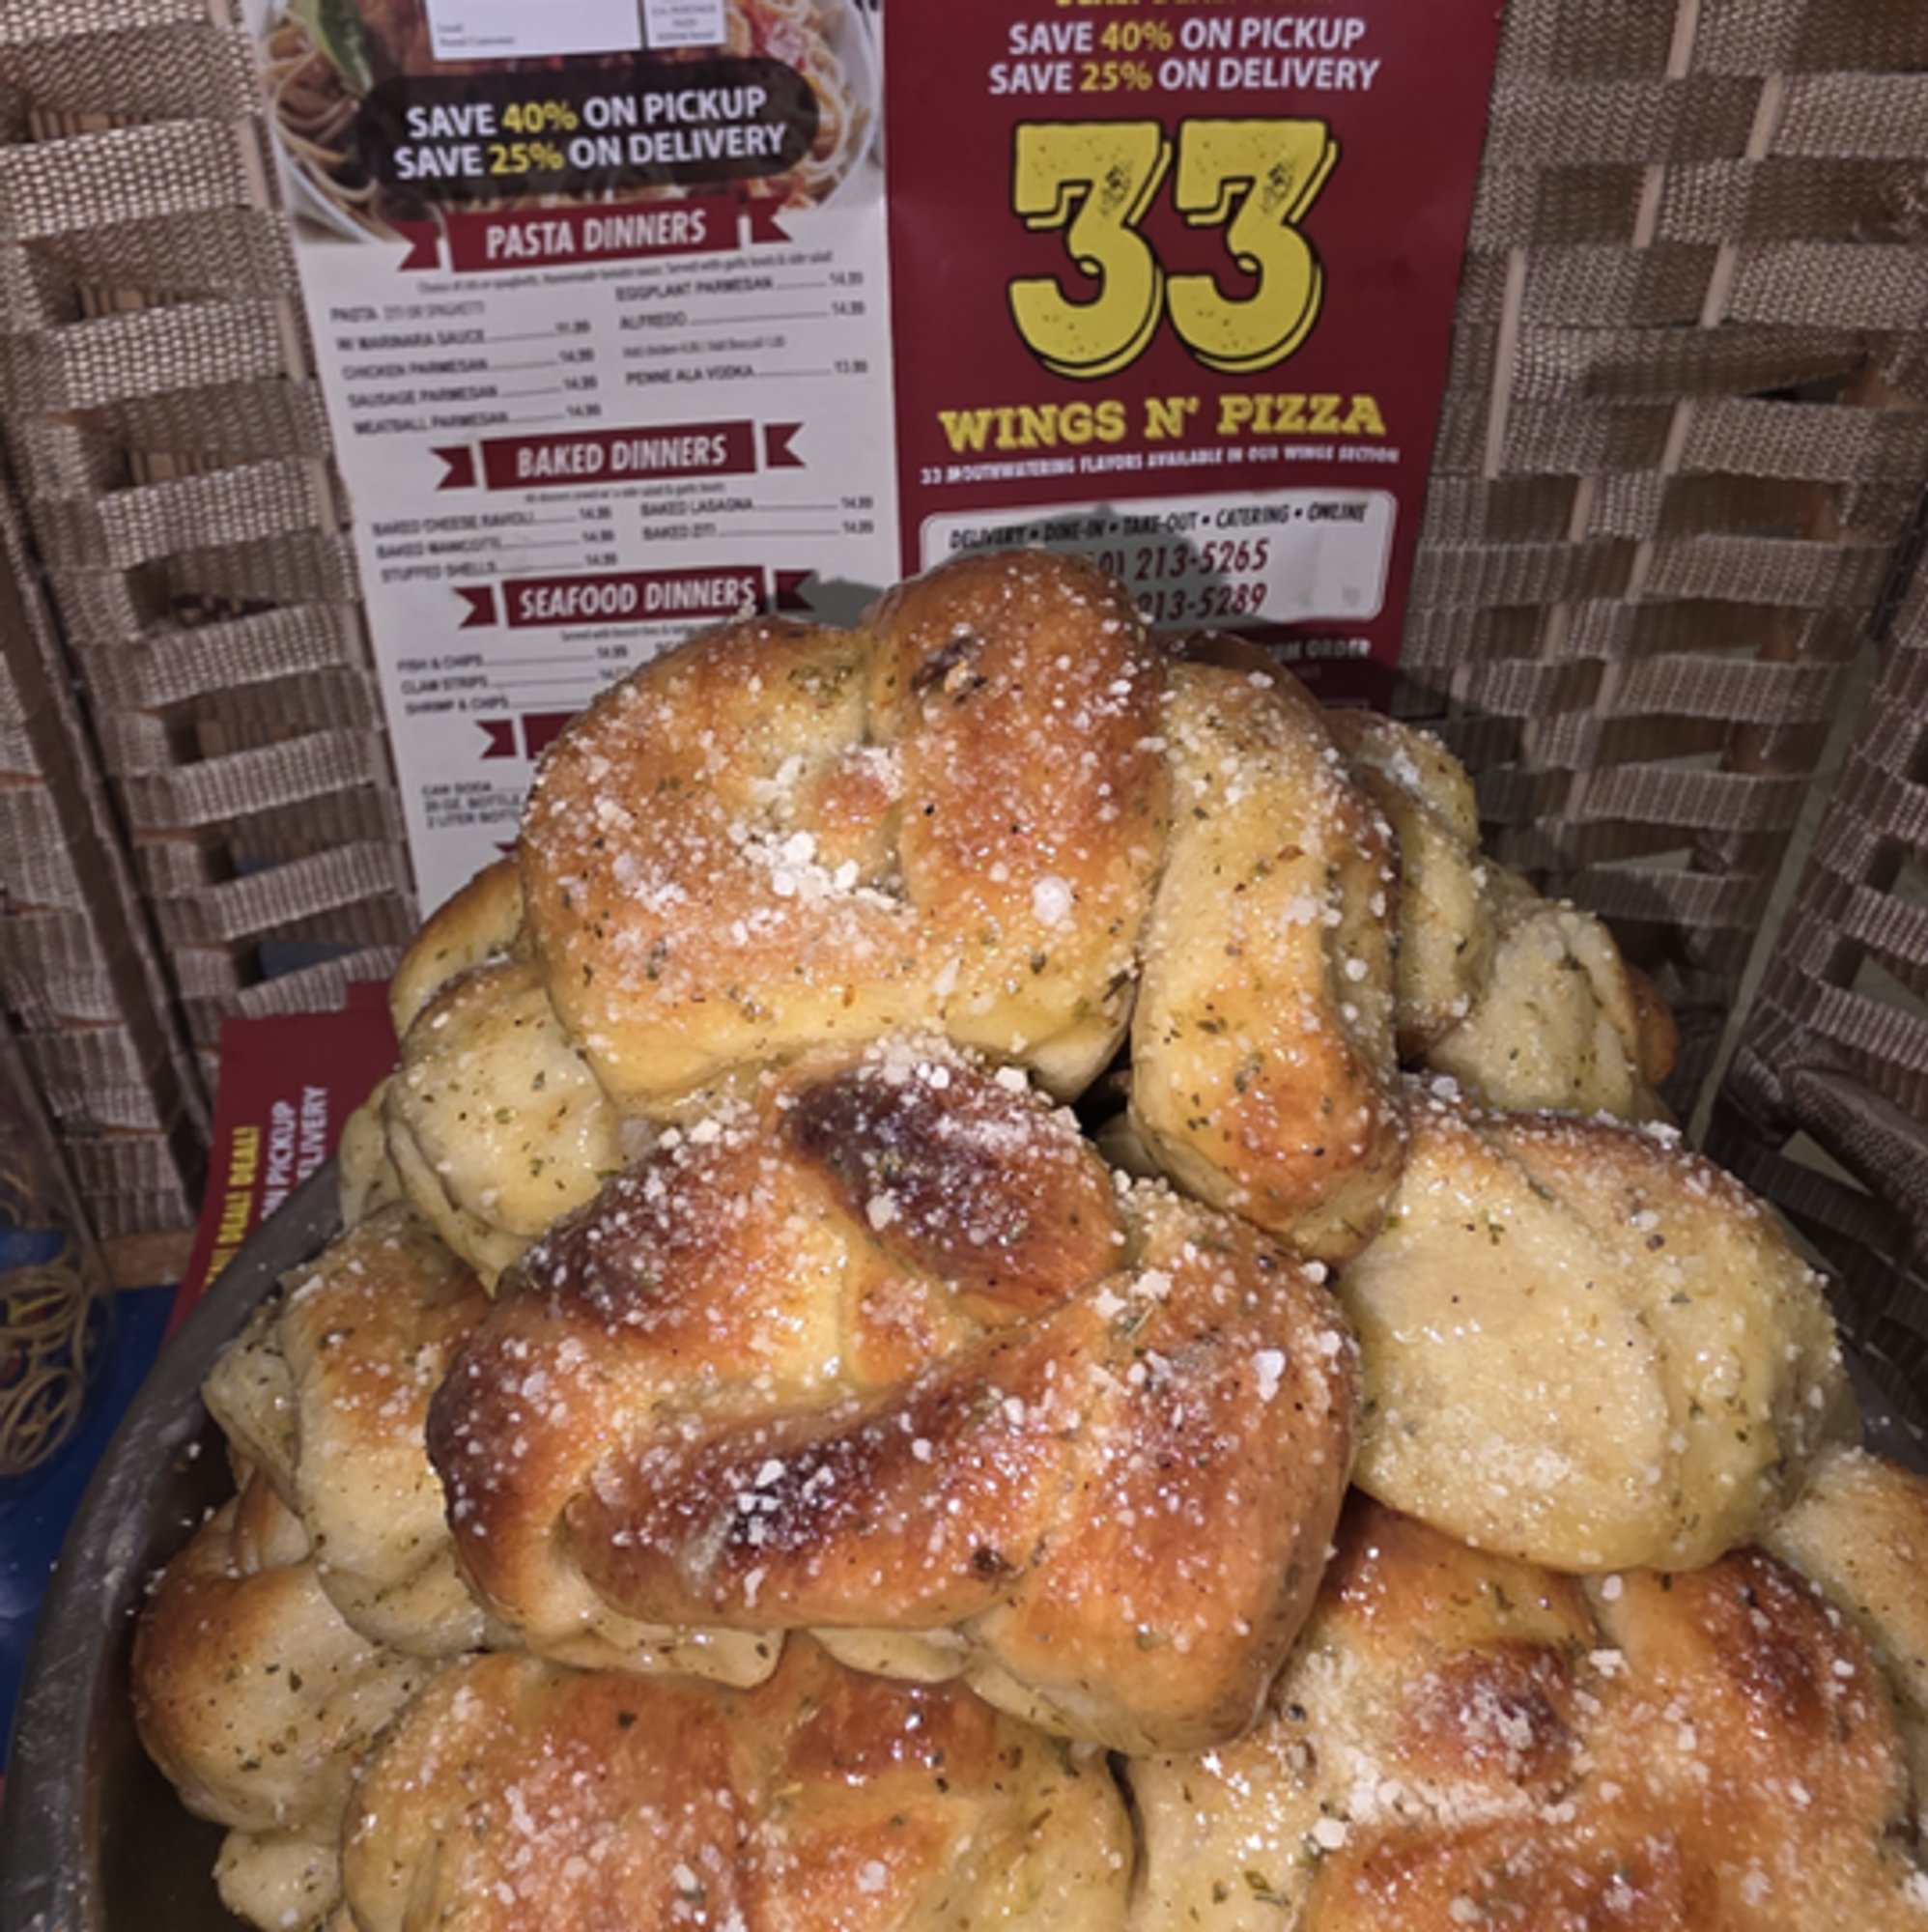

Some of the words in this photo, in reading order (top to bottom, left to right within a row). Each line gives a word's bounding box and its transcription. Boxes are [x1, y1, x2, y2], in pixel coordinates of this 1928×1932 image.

[1007, 21, 1092, 55] SAVE
[1100, 20, 1174, 51] 40%
[1180, 17, 1233, 50] ON
[1240, 15, 1365, 50] PICKUP
[988, 62, 1072, 95] SAVE
[1080, 61, 1152, 92] 25%
[1159, 58, 1209, 91] ON
[1218, 57, 1380, 91] DELIVERY
[407, 103, 496, 139] SAVE
[501, 99, 579, 133] 40%
[583, 95, 638, 129] ON
[644, 86, 767, 125] PICKUP
[394, 145, 483, 180] SAVE
[488, 141, 564, 174] 25%
[569, 136, 621, 169] ON
[629, 123, 786, 164] DELIVERY
[486, 221, 574, 260] PASTA
[583, 209, 706, 251] DINNERS
[1007, 117, 1341, 381] 33
[615, 282, 693, 301] EGGPLANT
[695, 276, 772, 294] PARMESAN
[619, 311, 687, 330] ALFREDO
[341, 363, 406, 380] CHICKEN
[409, 358, 488, 375] PARMESAN
[626, 371, 672, 386] PENNE
[705, 364, 756, 381] VODKA
[348, 391, 415, 409] SAUSAGE
[419, 385, 498, 403] PARMESAN
[431, 412, 509, 428] PARMESAN
[938, 399, 1126, 453] WINGS
[1144, 395, 1200, 439] N'
[1217, 393, 1386, 437] PIZZA
[517, 442, 606, 478] BAKED
[611, 435, 726, 470] DINNERS
[921, 467, 943, 485] 33
[1080, 453, 1143, 472] FLAVORS
[1148, 447, 1223, 469] AVAILABLE
[1227, 445, 1243, 463] IN
[1248, 444, 1279, 463] OUR
[640, 501, 686, 518] BAKED
[690, 497, 753, 514] LASAGNA
[949, 526, 1026, 550] DELIVERY
[1044, 518, 1106, 541] DINE-IN
[1122, 511, 1199, 535] TAKE-OUT
[1216, 504, 1290, 528] CATERING
[1307, 501, 1368, 523] ONLINE
[643, 526, 689, 541] BAKED
[446, 560, 497, 577] SHELLS
[1134, 538, 1269, 582] 213-5265
[520, 582, 638, 620] SEAFOOD
[644, 577, 756, 611] DINNERS
[397, 658, 427, 672] FISH
[443, 654, 484, 668] CHIPS
[442, 677, 488, 693] STRIPS
[472, 696, 509, 710] CHIPS
[265, 1100, 297, 1186] PICKUP
[296, 1084, 328, 1180] ELIVERY
[227, 1125, 261, 1187] DEAL!
